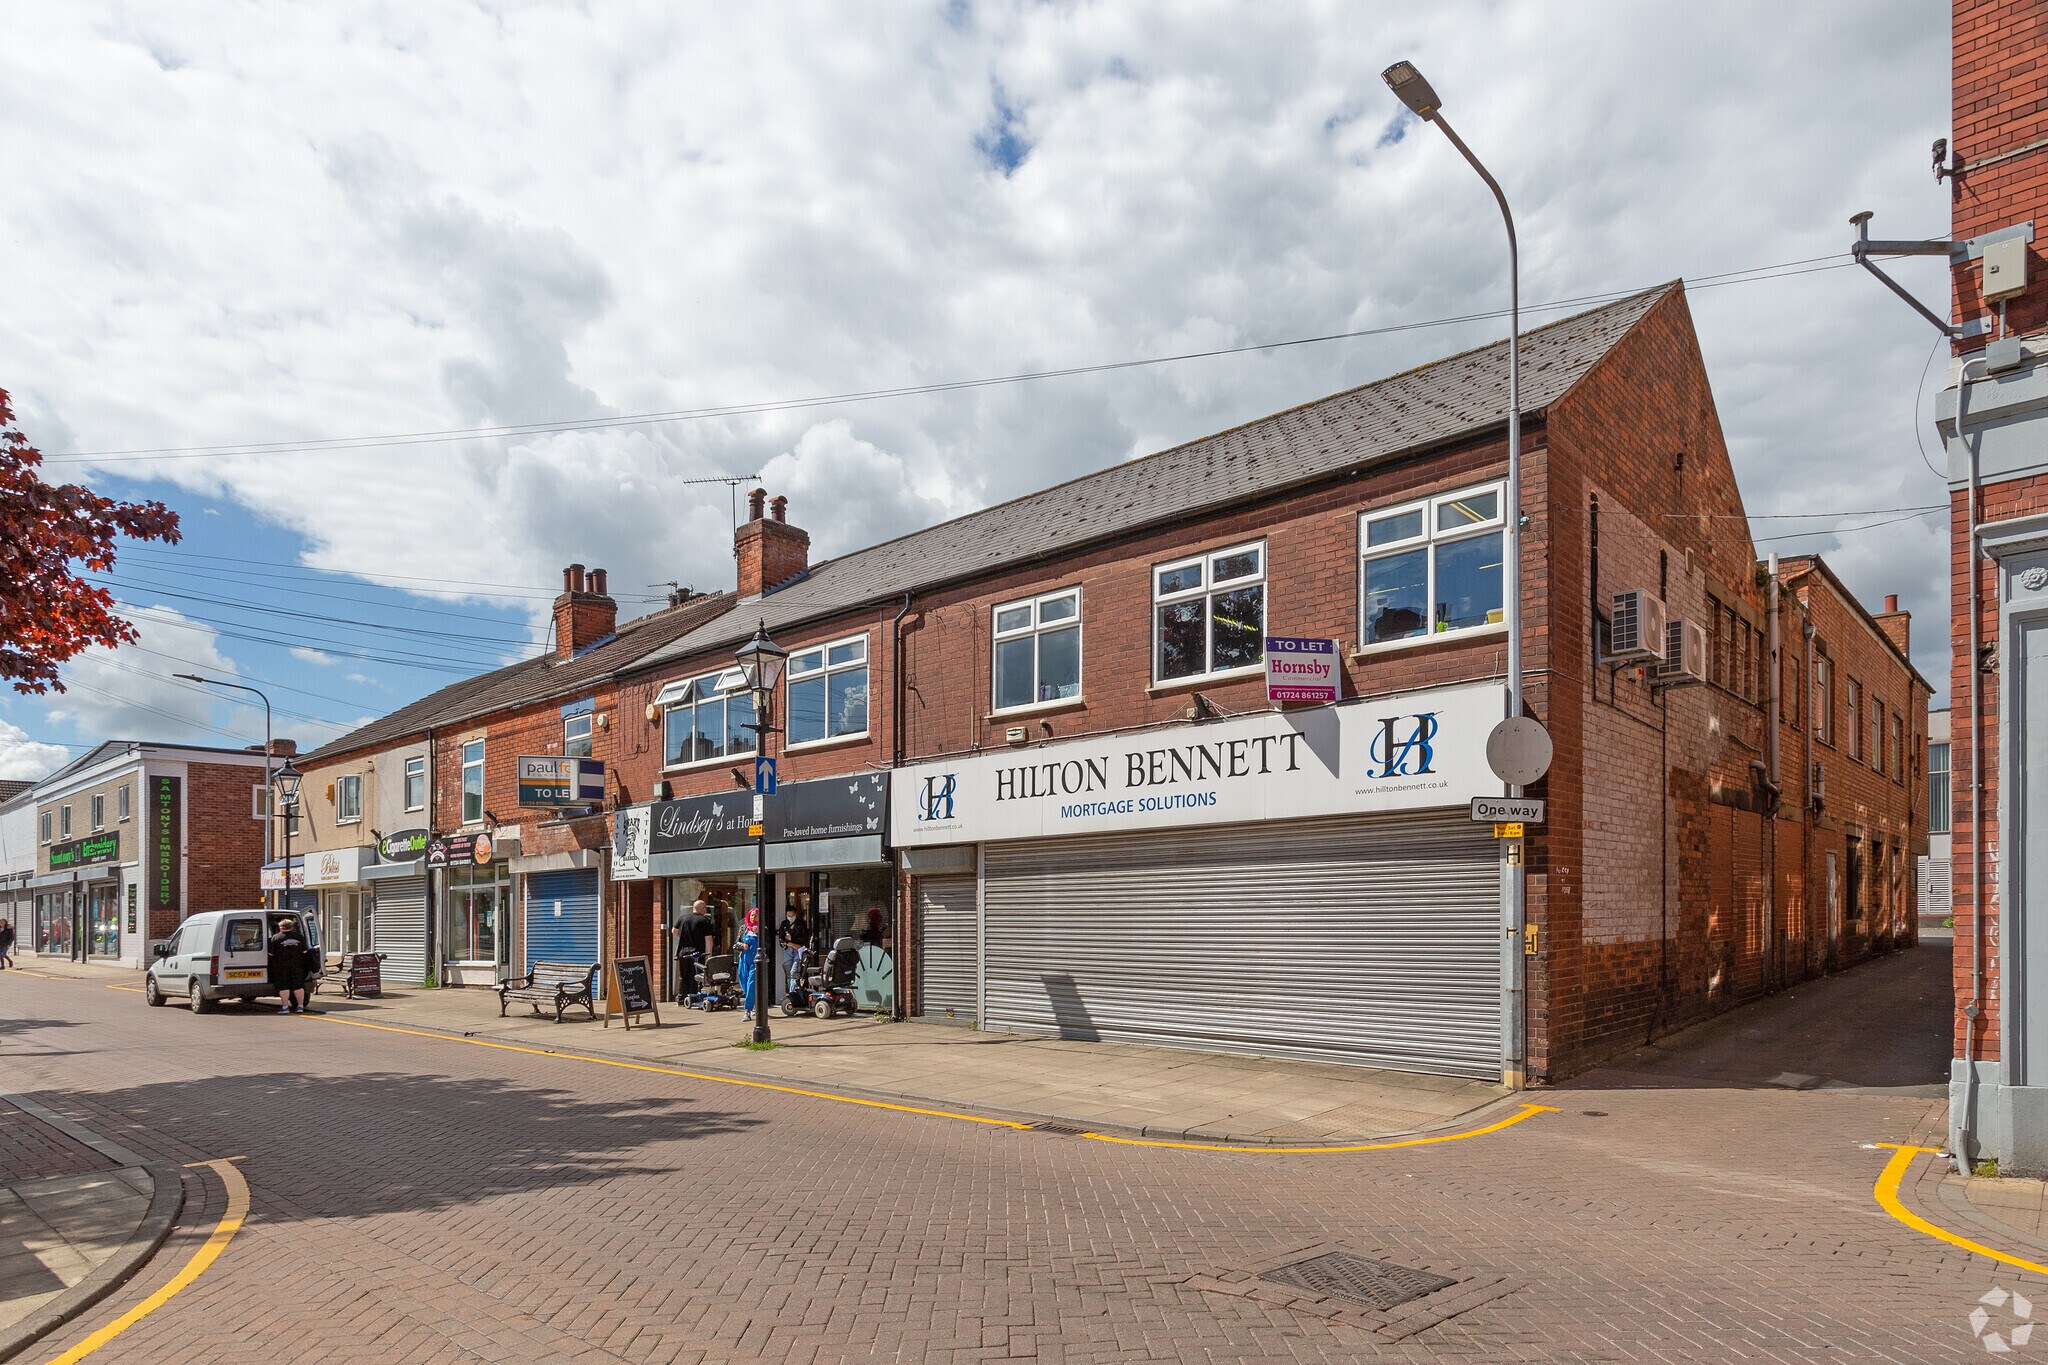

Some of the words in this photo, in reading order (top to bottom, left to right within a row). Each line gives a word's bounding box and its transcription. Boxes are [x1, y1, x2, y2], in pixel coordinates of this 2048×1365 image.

[1275, 641, 1296, 650] TO
[1301, 641, 1325, 651] LET
[1272, 659, 1330, 678] Hornsby
[1277, 691, 1300, 699] 01724
[527, 761, 558, 776] paul
[995, 755, 1109, 802] HILTON
[1125, 731, 1305, 788] BENNETT
[535, 789, 552, 798] TO
[555, 789, 570, 798] LE
[1061, 800, 1134, 819] MORTGAGE
[1138, 791, 1217, 812] SOLUTIONS
[1478, 803, 1505, 815] One
[1510, 807, 1538, 818] way
[656, 805, 725, 847] Lindsey's
[727, 819, 735, 830] at
[783, 826, 810, 837] Pre-loved
[811, 826, 827, 835] home
[828, 822, 863, 834] furnishings
[619, 964, 645, 975] Supporting
[621, 976, 633, 985] Your
[622, 985, 636, 993] Local
